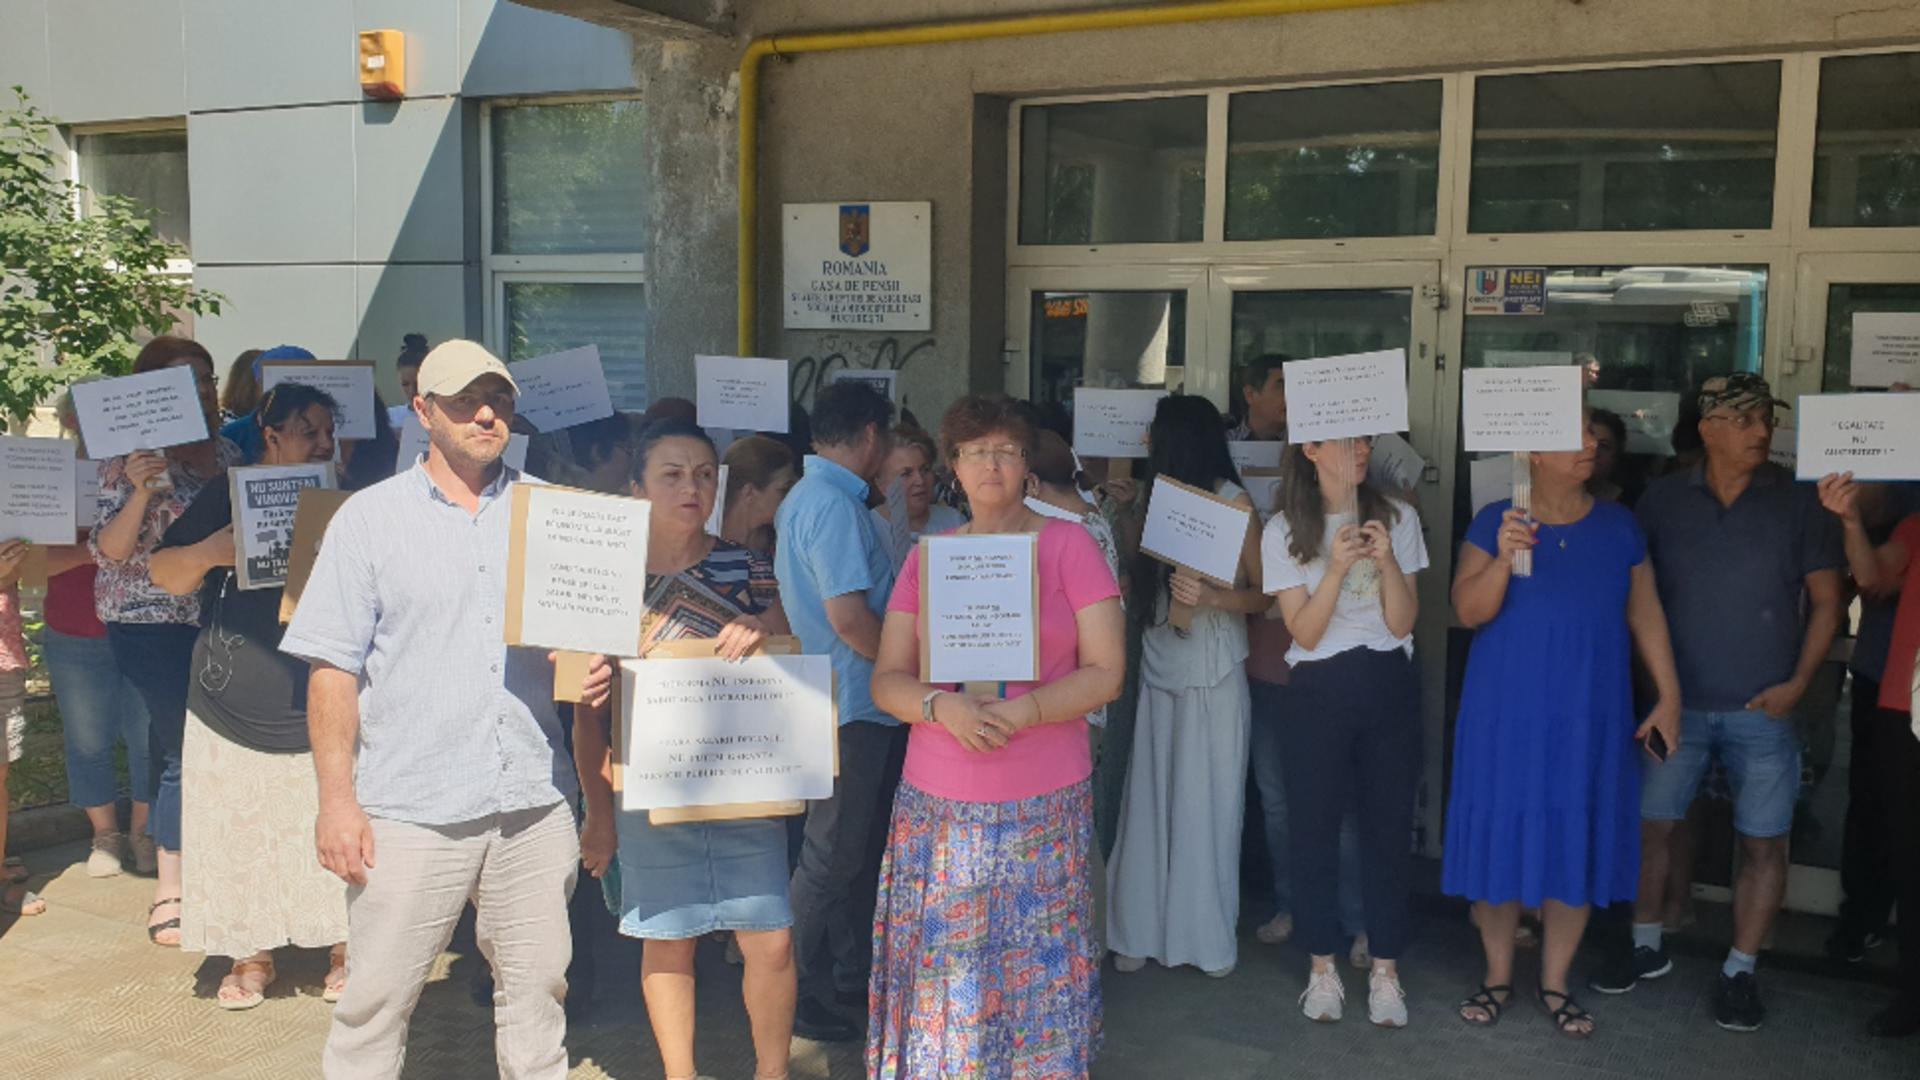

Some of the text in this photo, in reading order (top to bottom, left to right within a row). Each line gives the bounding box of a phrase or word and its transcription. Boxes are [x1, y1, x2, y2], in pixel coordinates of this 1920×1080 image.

[822, 260, 888, 276] ROMANIA
[810, 280, 900, 292] CASA DE PENSII
[250, 483, 266, 493] NU
